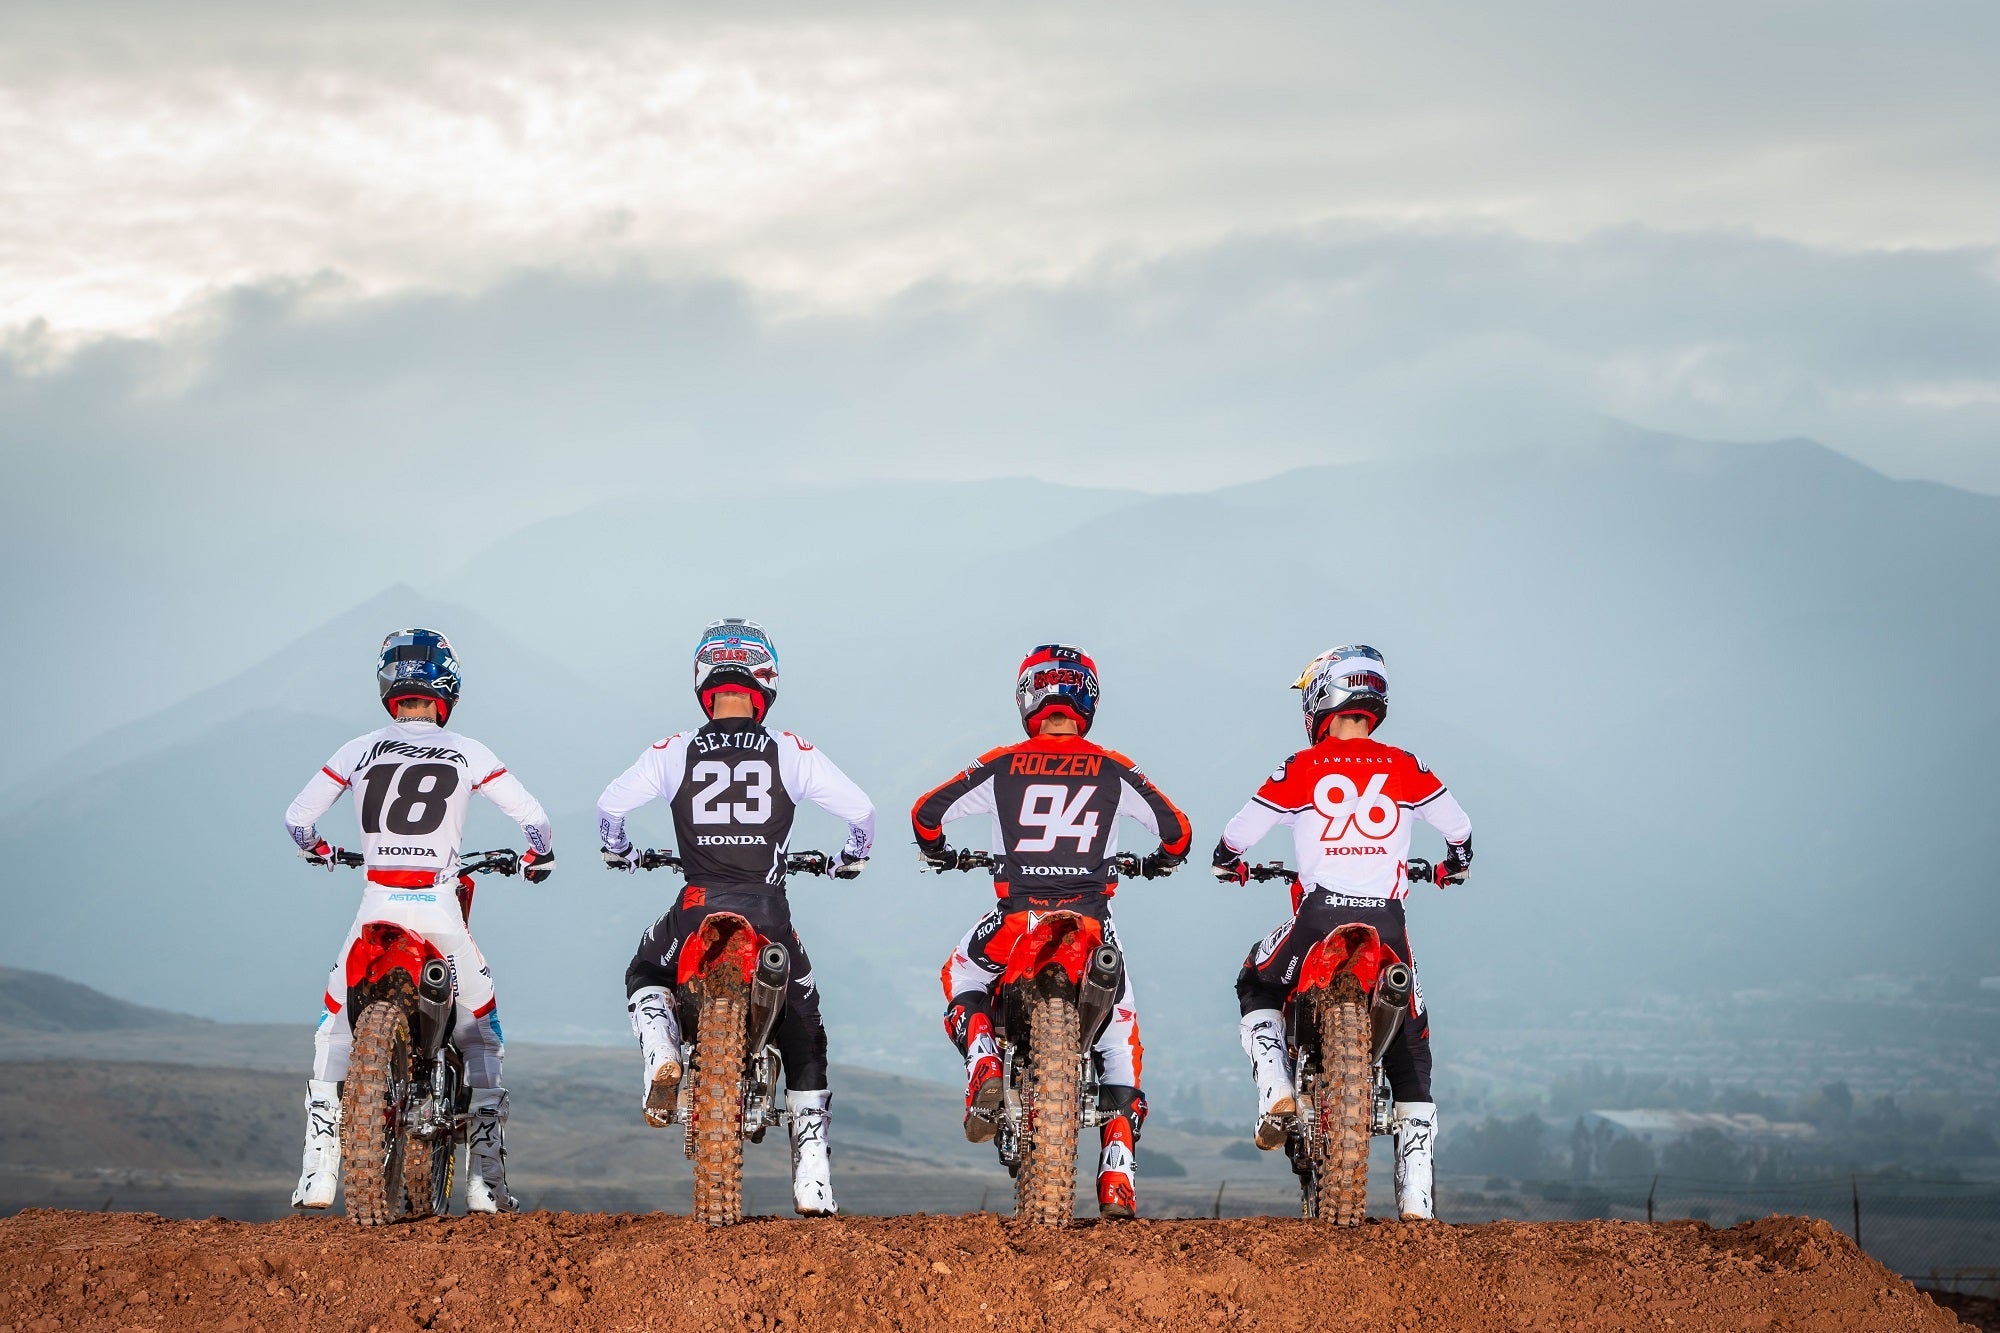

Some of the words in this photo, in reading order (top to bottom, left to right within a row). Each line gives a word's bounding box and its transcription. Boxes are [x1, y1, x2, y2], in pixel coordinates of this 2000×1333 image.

[712, 649, 748, 662] CHASE
[694, 732, 771, 754] SEXTON
[354, 740, 469, 772] LAWRENCE
[1009, 753, 1103, 776] ROCZEN
[1313, 757, 1393, 765] LAWRENCE
[361, 763, 459, 835] 18
[692, 760, 772, 825] 23
[1313, 773, 1400, 841] 96
[1014, 784, 1101, 853] 94
[696, 835, 768, 845] HONDA
[377, 846, 438, 857] HONDA
[1324, 846, 1388, 856] HONDA
[1020, 865, 1092, 876] HONDA
[387, 893, 437, 902] ASTARS
[1324, 894, 1386, 908] alpinestars
[1284, 955, 1299, 981] HONDA
